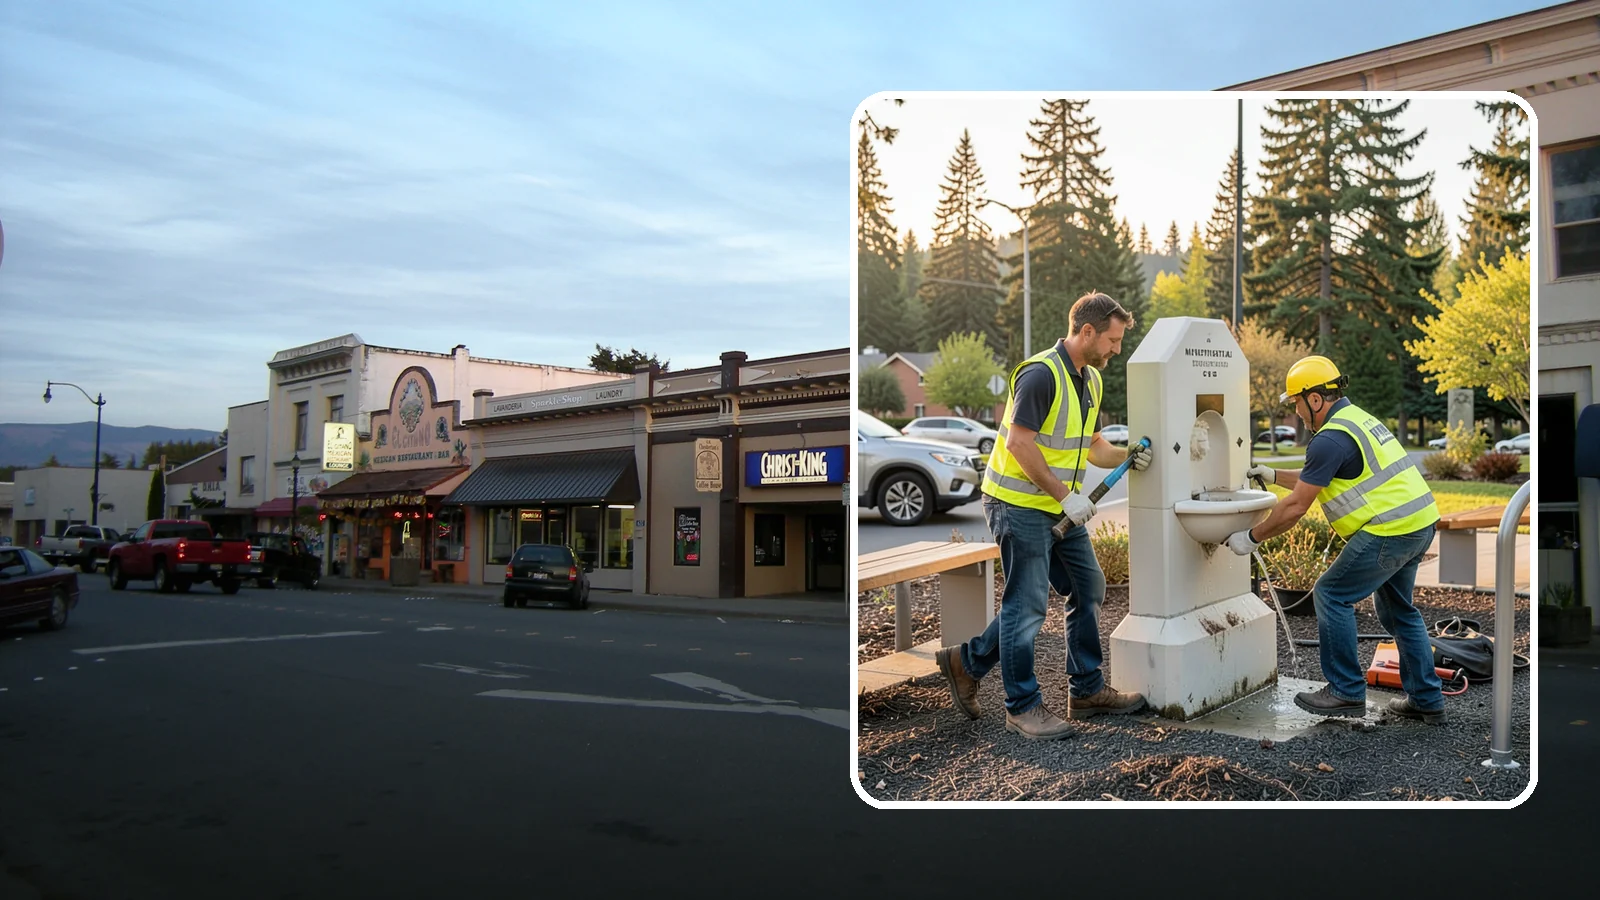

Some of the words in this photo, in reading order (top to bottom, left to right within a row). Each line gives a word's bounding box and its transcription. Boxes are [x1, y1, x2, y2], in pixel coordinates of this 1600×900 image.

[531, 398, 560, 409] Sparkle
[561, 394, 582, 405] Shop
[595, 389, 623, 400] LAUNDRY
[493, 402, 522, 412] LAVANDERIA
[374, 455, 396, 464] MEXICAN
[398, 451, 433, 462] RESTAURANT
[438, 450, 450, 459] BAR
[799, 450, 827, 476] KING
